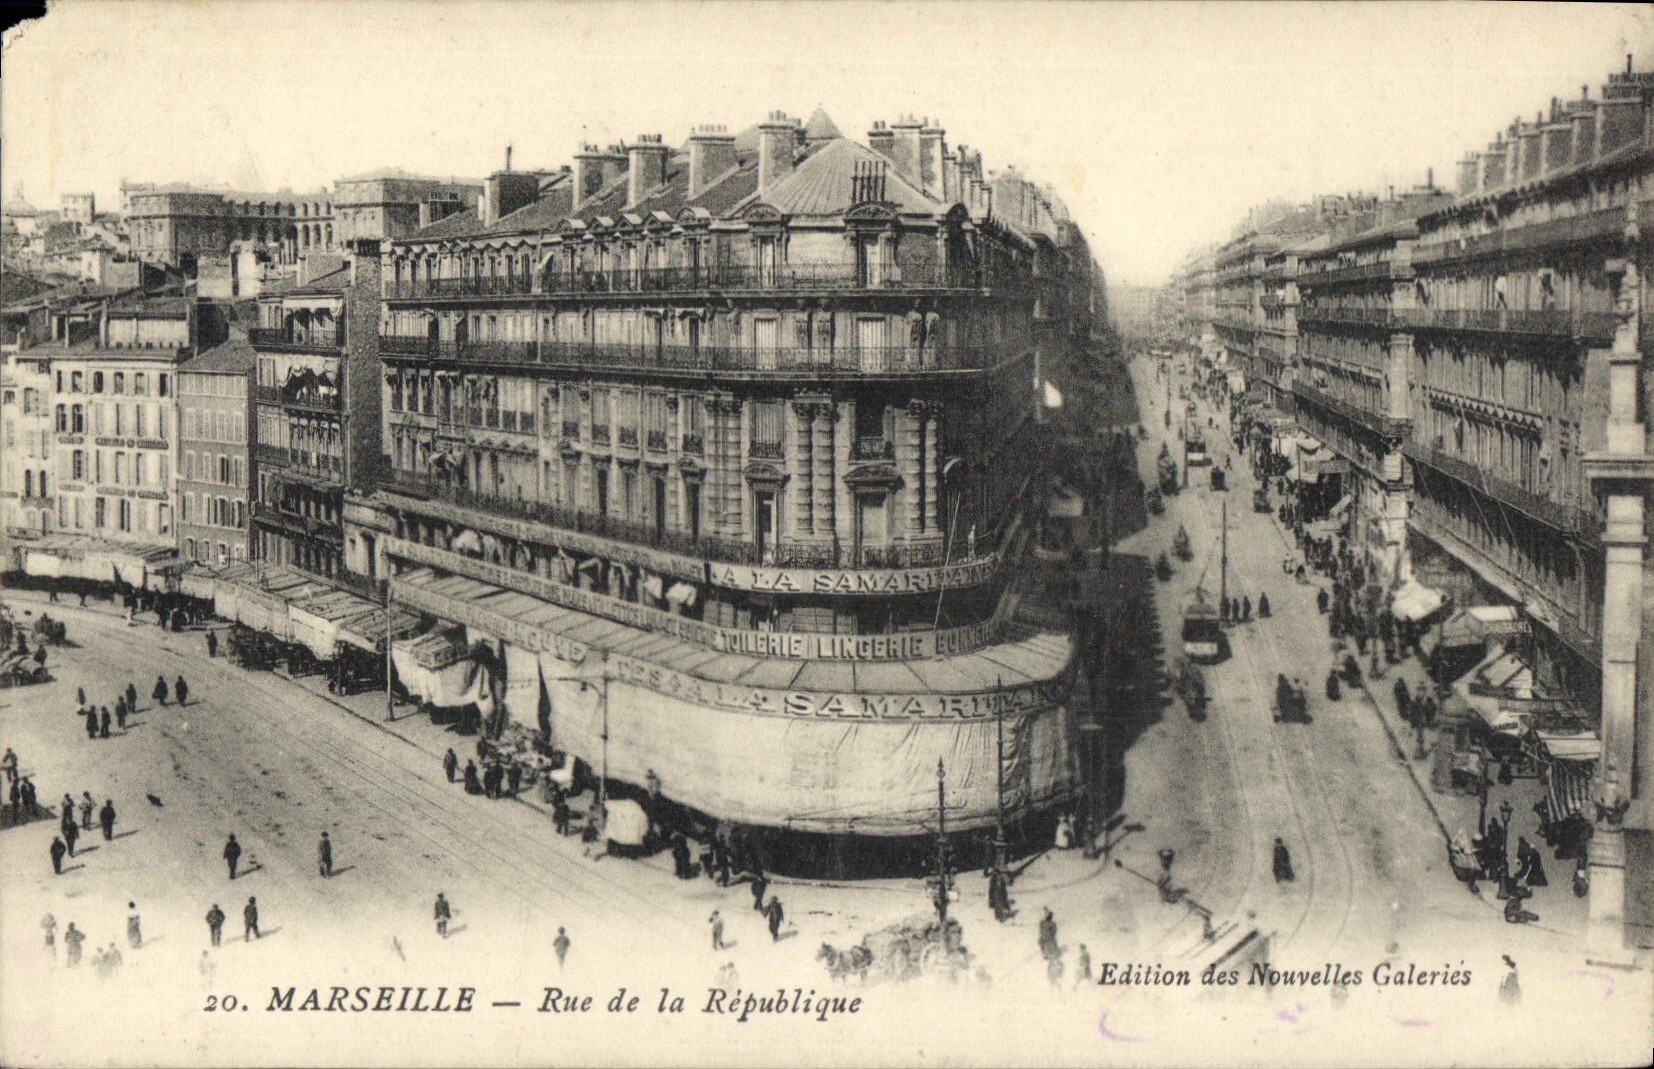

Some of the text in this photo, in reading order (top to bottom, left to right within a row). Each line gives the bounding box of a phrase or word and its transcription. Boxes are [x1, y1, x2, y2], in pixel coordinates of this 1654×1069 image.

[721, 568, 741, 588] A
[751, 570, 801, 592] LA
[817, 635, 924, 660] LINGERIE
[714, 689, 778, 715] LA
